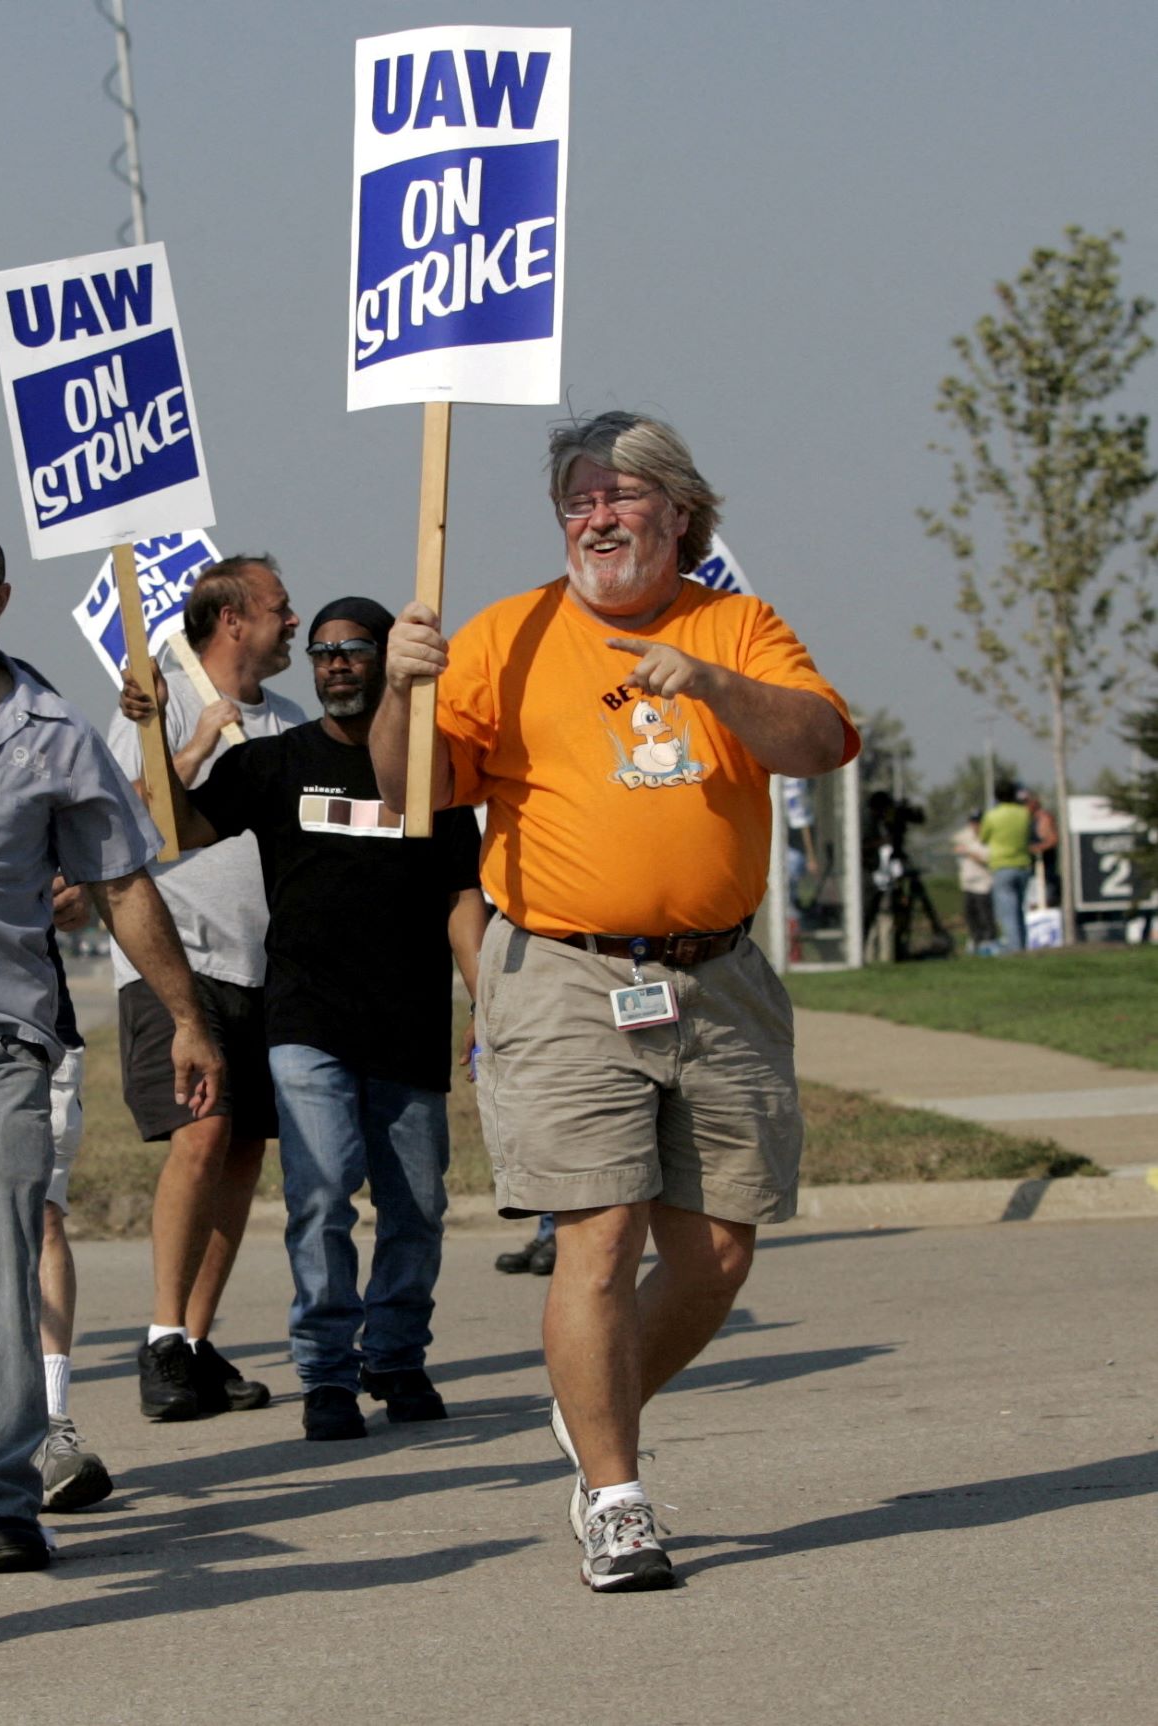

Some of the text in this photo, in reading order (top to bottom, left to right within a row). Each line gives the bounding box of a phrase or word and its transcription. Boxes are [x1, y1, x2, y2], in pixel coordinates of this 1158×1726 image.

[372, 50, 551, 135] UAW
[401, 157, 483, 249] ON
[7, 263, 153, 347] UAW
[356, 216, 555, 361] STRIKE
[64, 355, 128, 433] ON
[32, 386, 187, 521] STRIKE
[1099, 854, 1133, 897] 2
